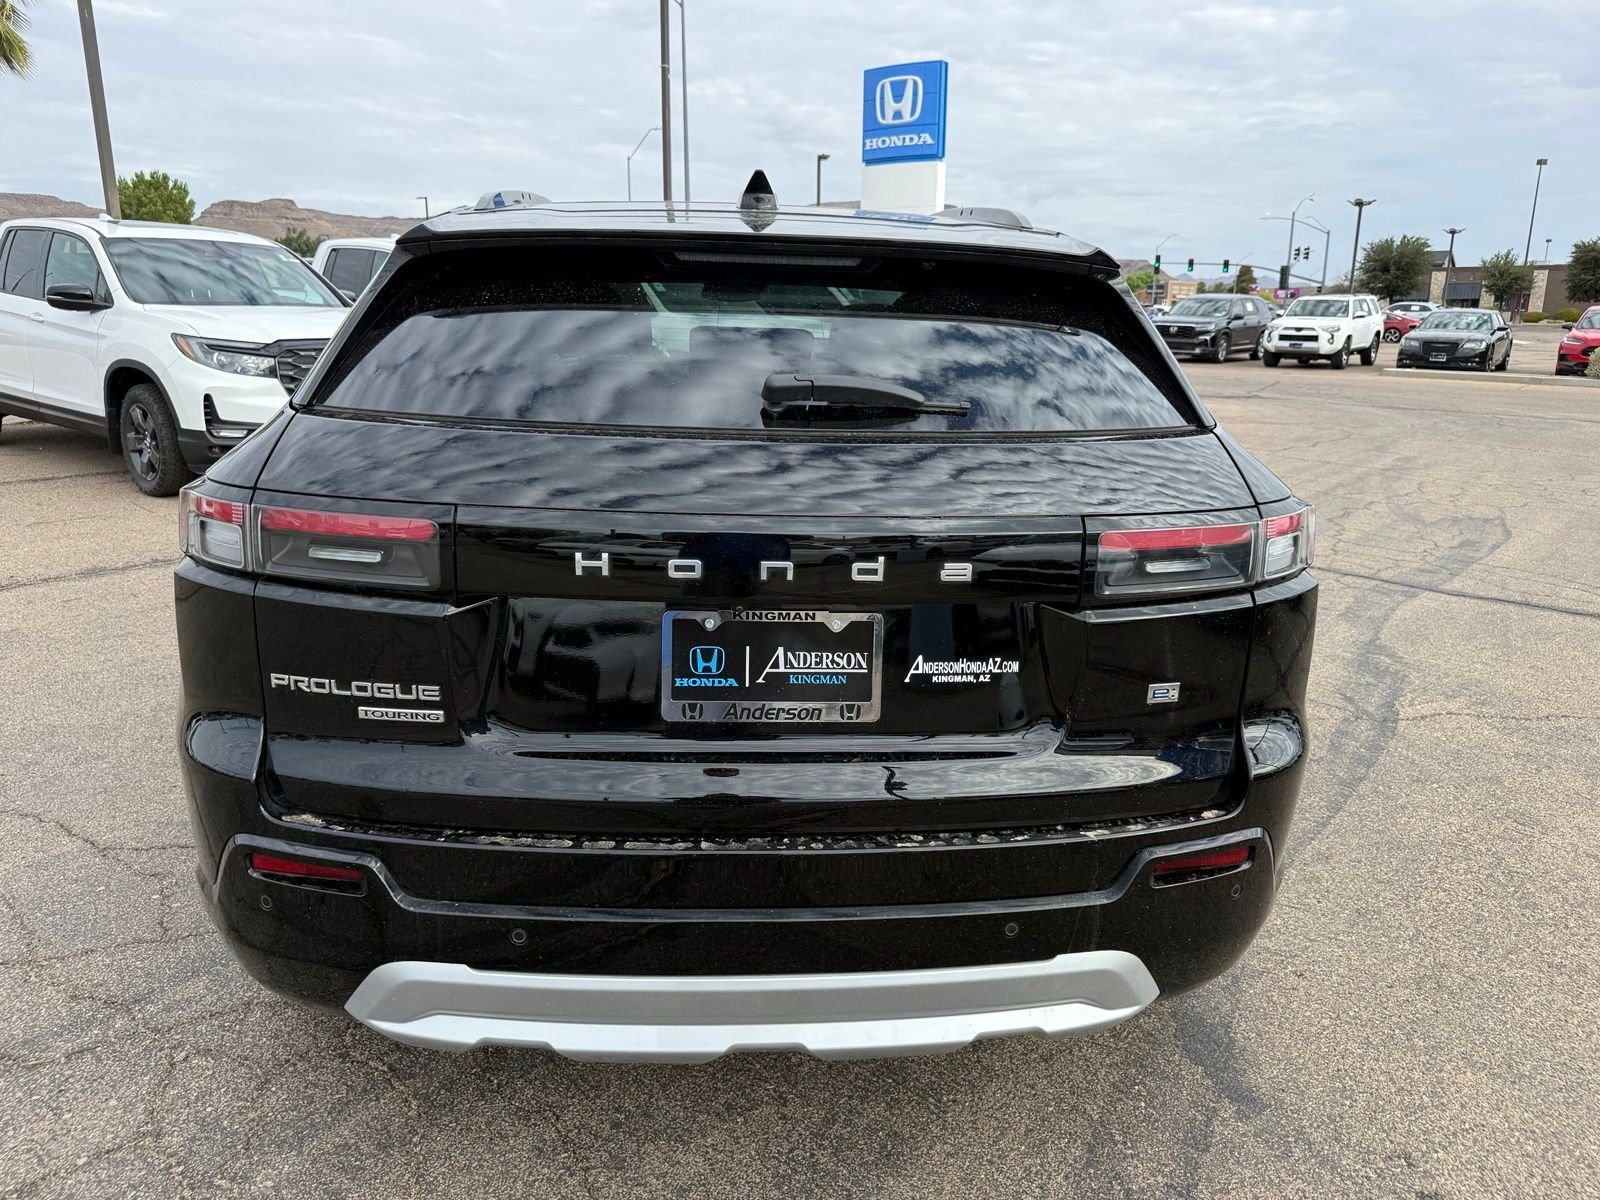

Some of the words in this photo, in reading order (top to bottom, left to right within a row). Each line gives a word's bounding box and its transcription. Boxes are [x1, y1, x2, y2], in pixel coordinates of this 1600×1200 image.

[864, 133, 935, 150] HONDA
[732, 610, 817, 622] KINGMAN
[755, 646, 868, 683] ANDERSON
[674, 677, 739, 687] HONDA
[789, 674, 847, 685] KINGMAN
[932, 675, 977, 684] KINGMAN,
[978, 674, 991, 682] AZ
[270, 672, 441, 701] PROLOGUE
[361, 708, 441, 721] TOURING
[722, 703, 823, 721] Anderson
